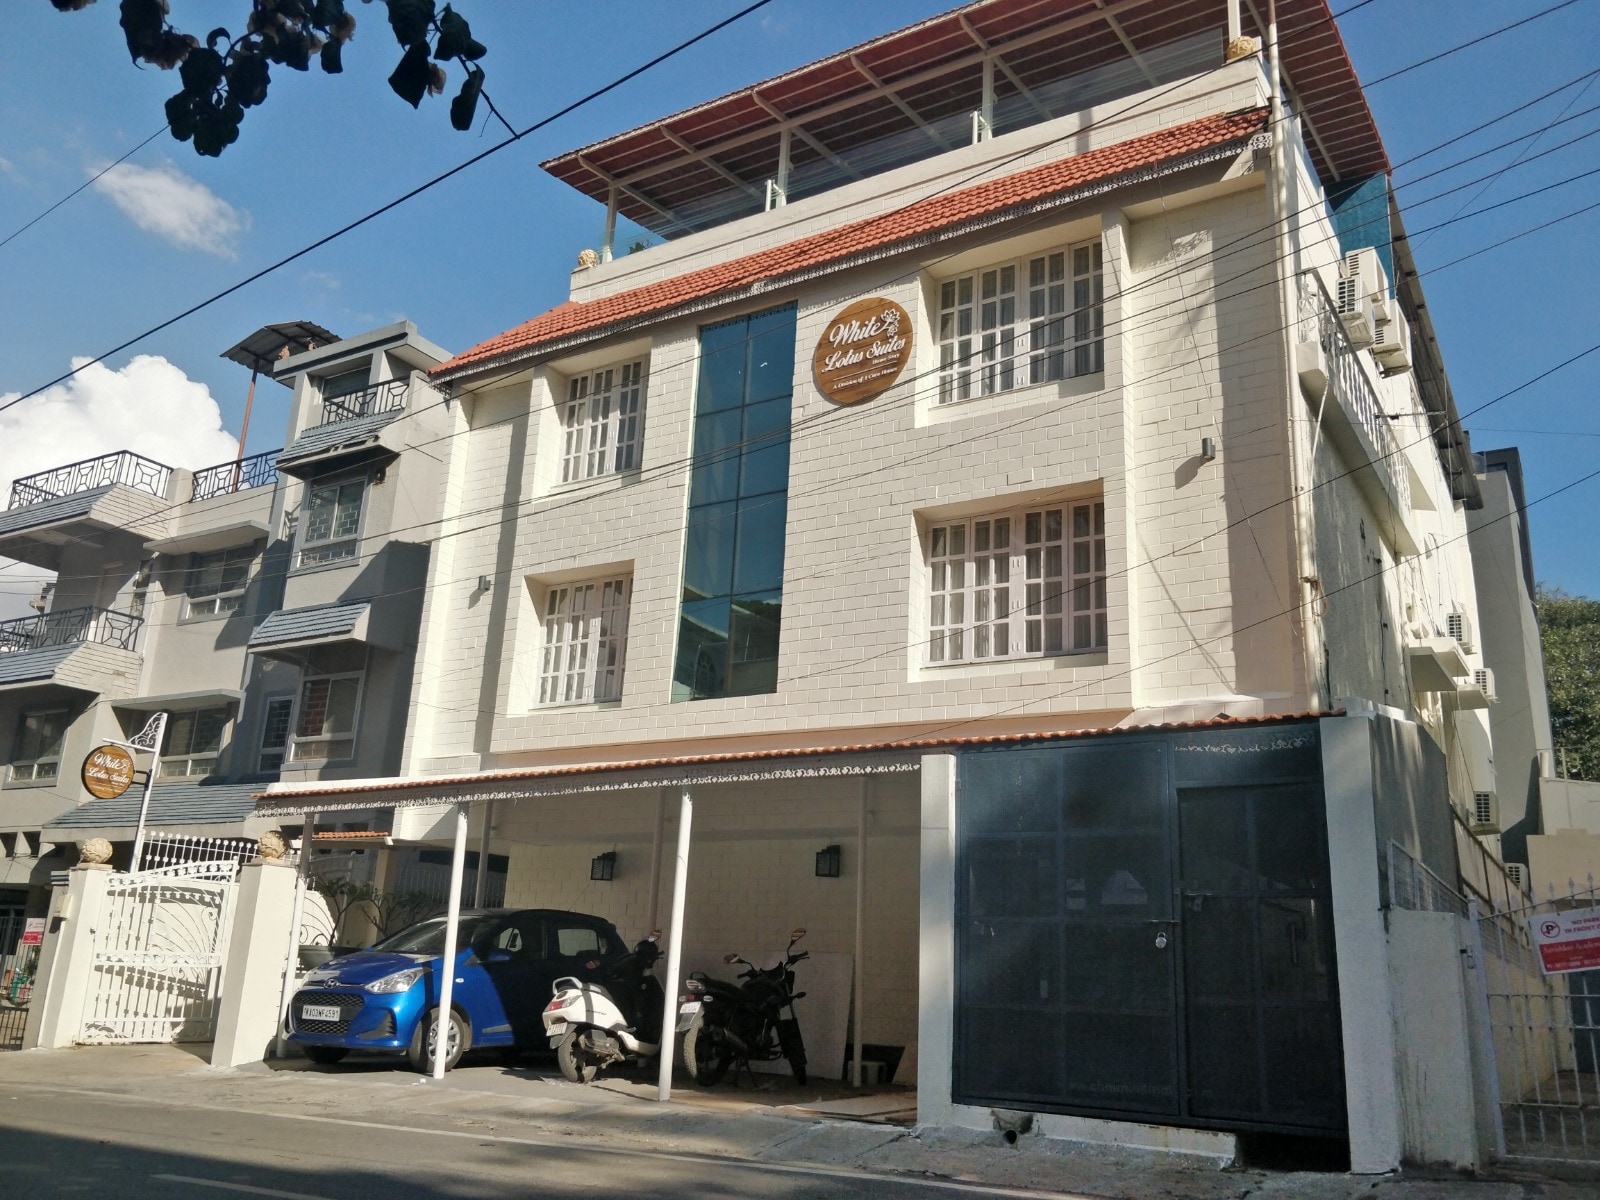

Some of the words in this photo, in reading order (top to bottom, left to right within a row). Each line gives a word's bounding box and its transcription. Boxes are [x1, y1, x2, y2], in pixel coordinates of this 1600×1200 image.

[829, 316, 884, 348] White
[821, 349, 864, 373] Lotus
[866, 335, 906, 359] Suites
[94, 753, 122, 770] White
[86, 767, 109, 779] Lotus
[110, 773, 130, 783] Suites
[1573, 924, 1595, 932] FRONT
